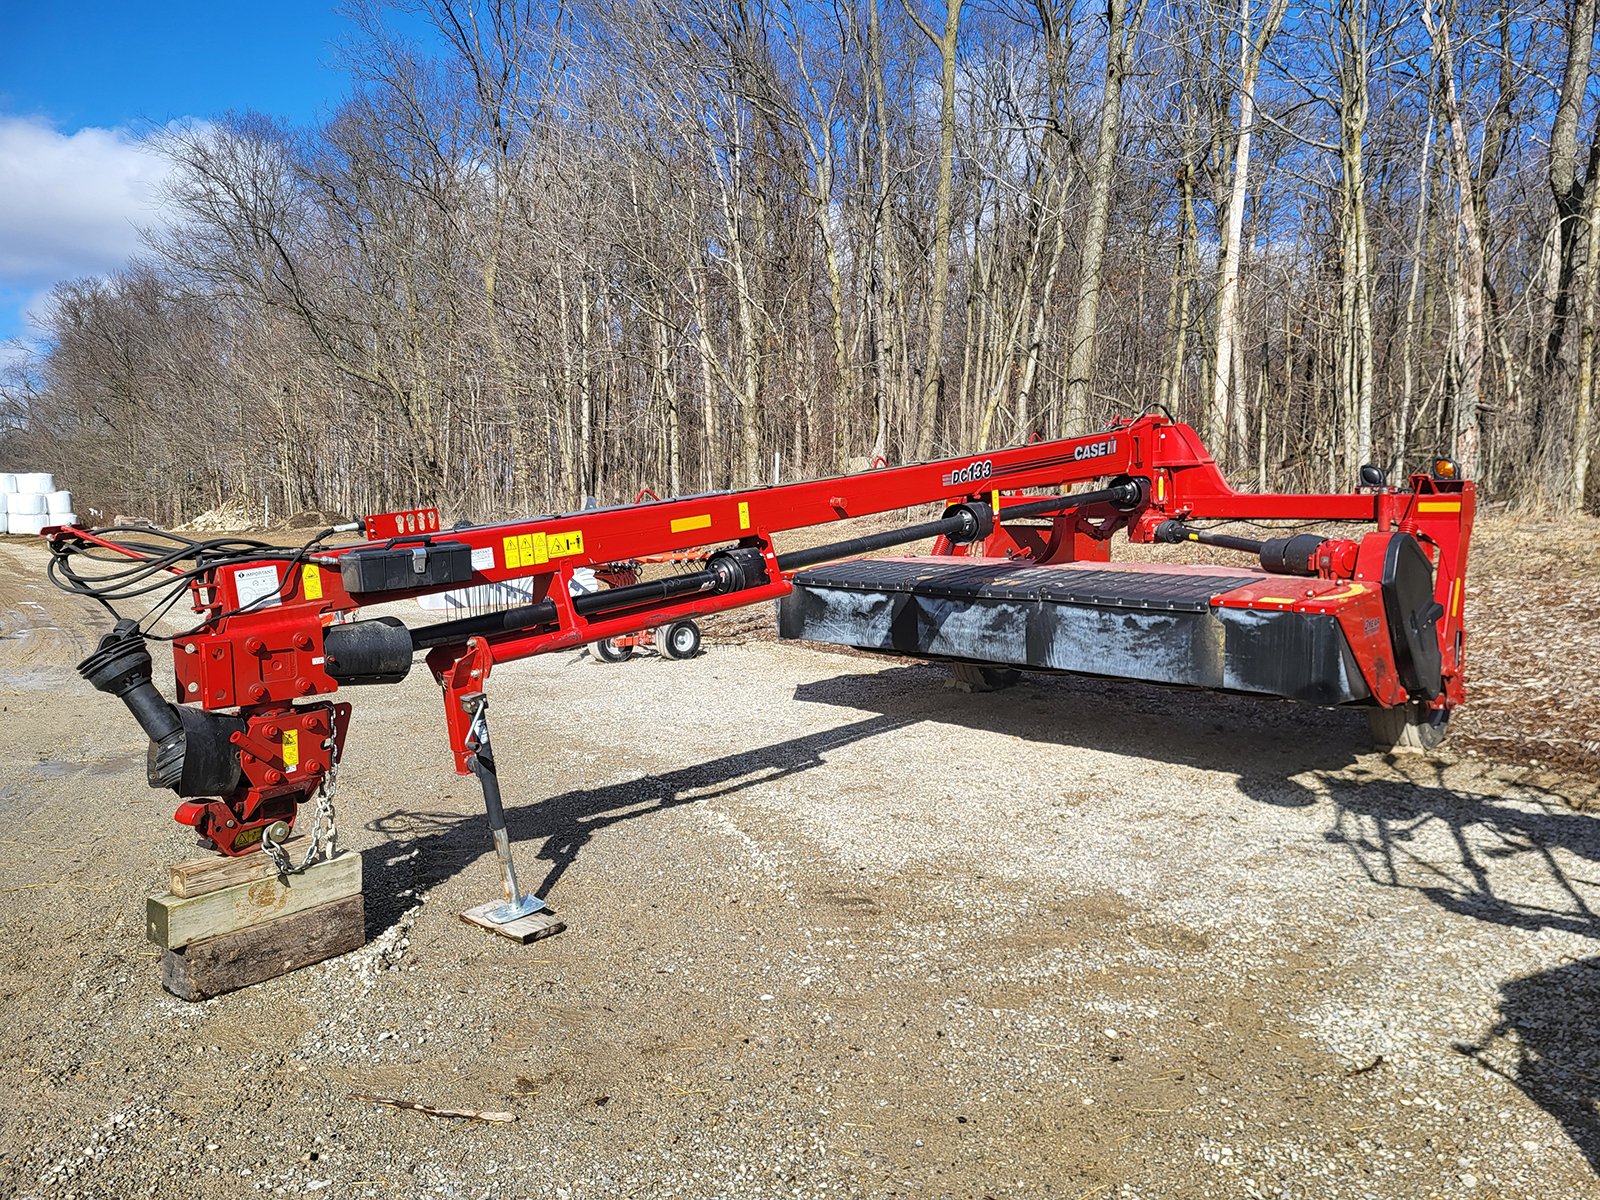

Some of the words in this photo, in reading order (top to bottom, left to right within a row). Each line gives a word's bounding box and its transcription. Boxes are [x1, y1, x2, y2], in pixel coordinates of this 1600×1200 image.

[1074, 442, 1106, 461] CASE
[952, 460, 992, 485] DC133
[245, 569, 274, 578] IMPORTANT
